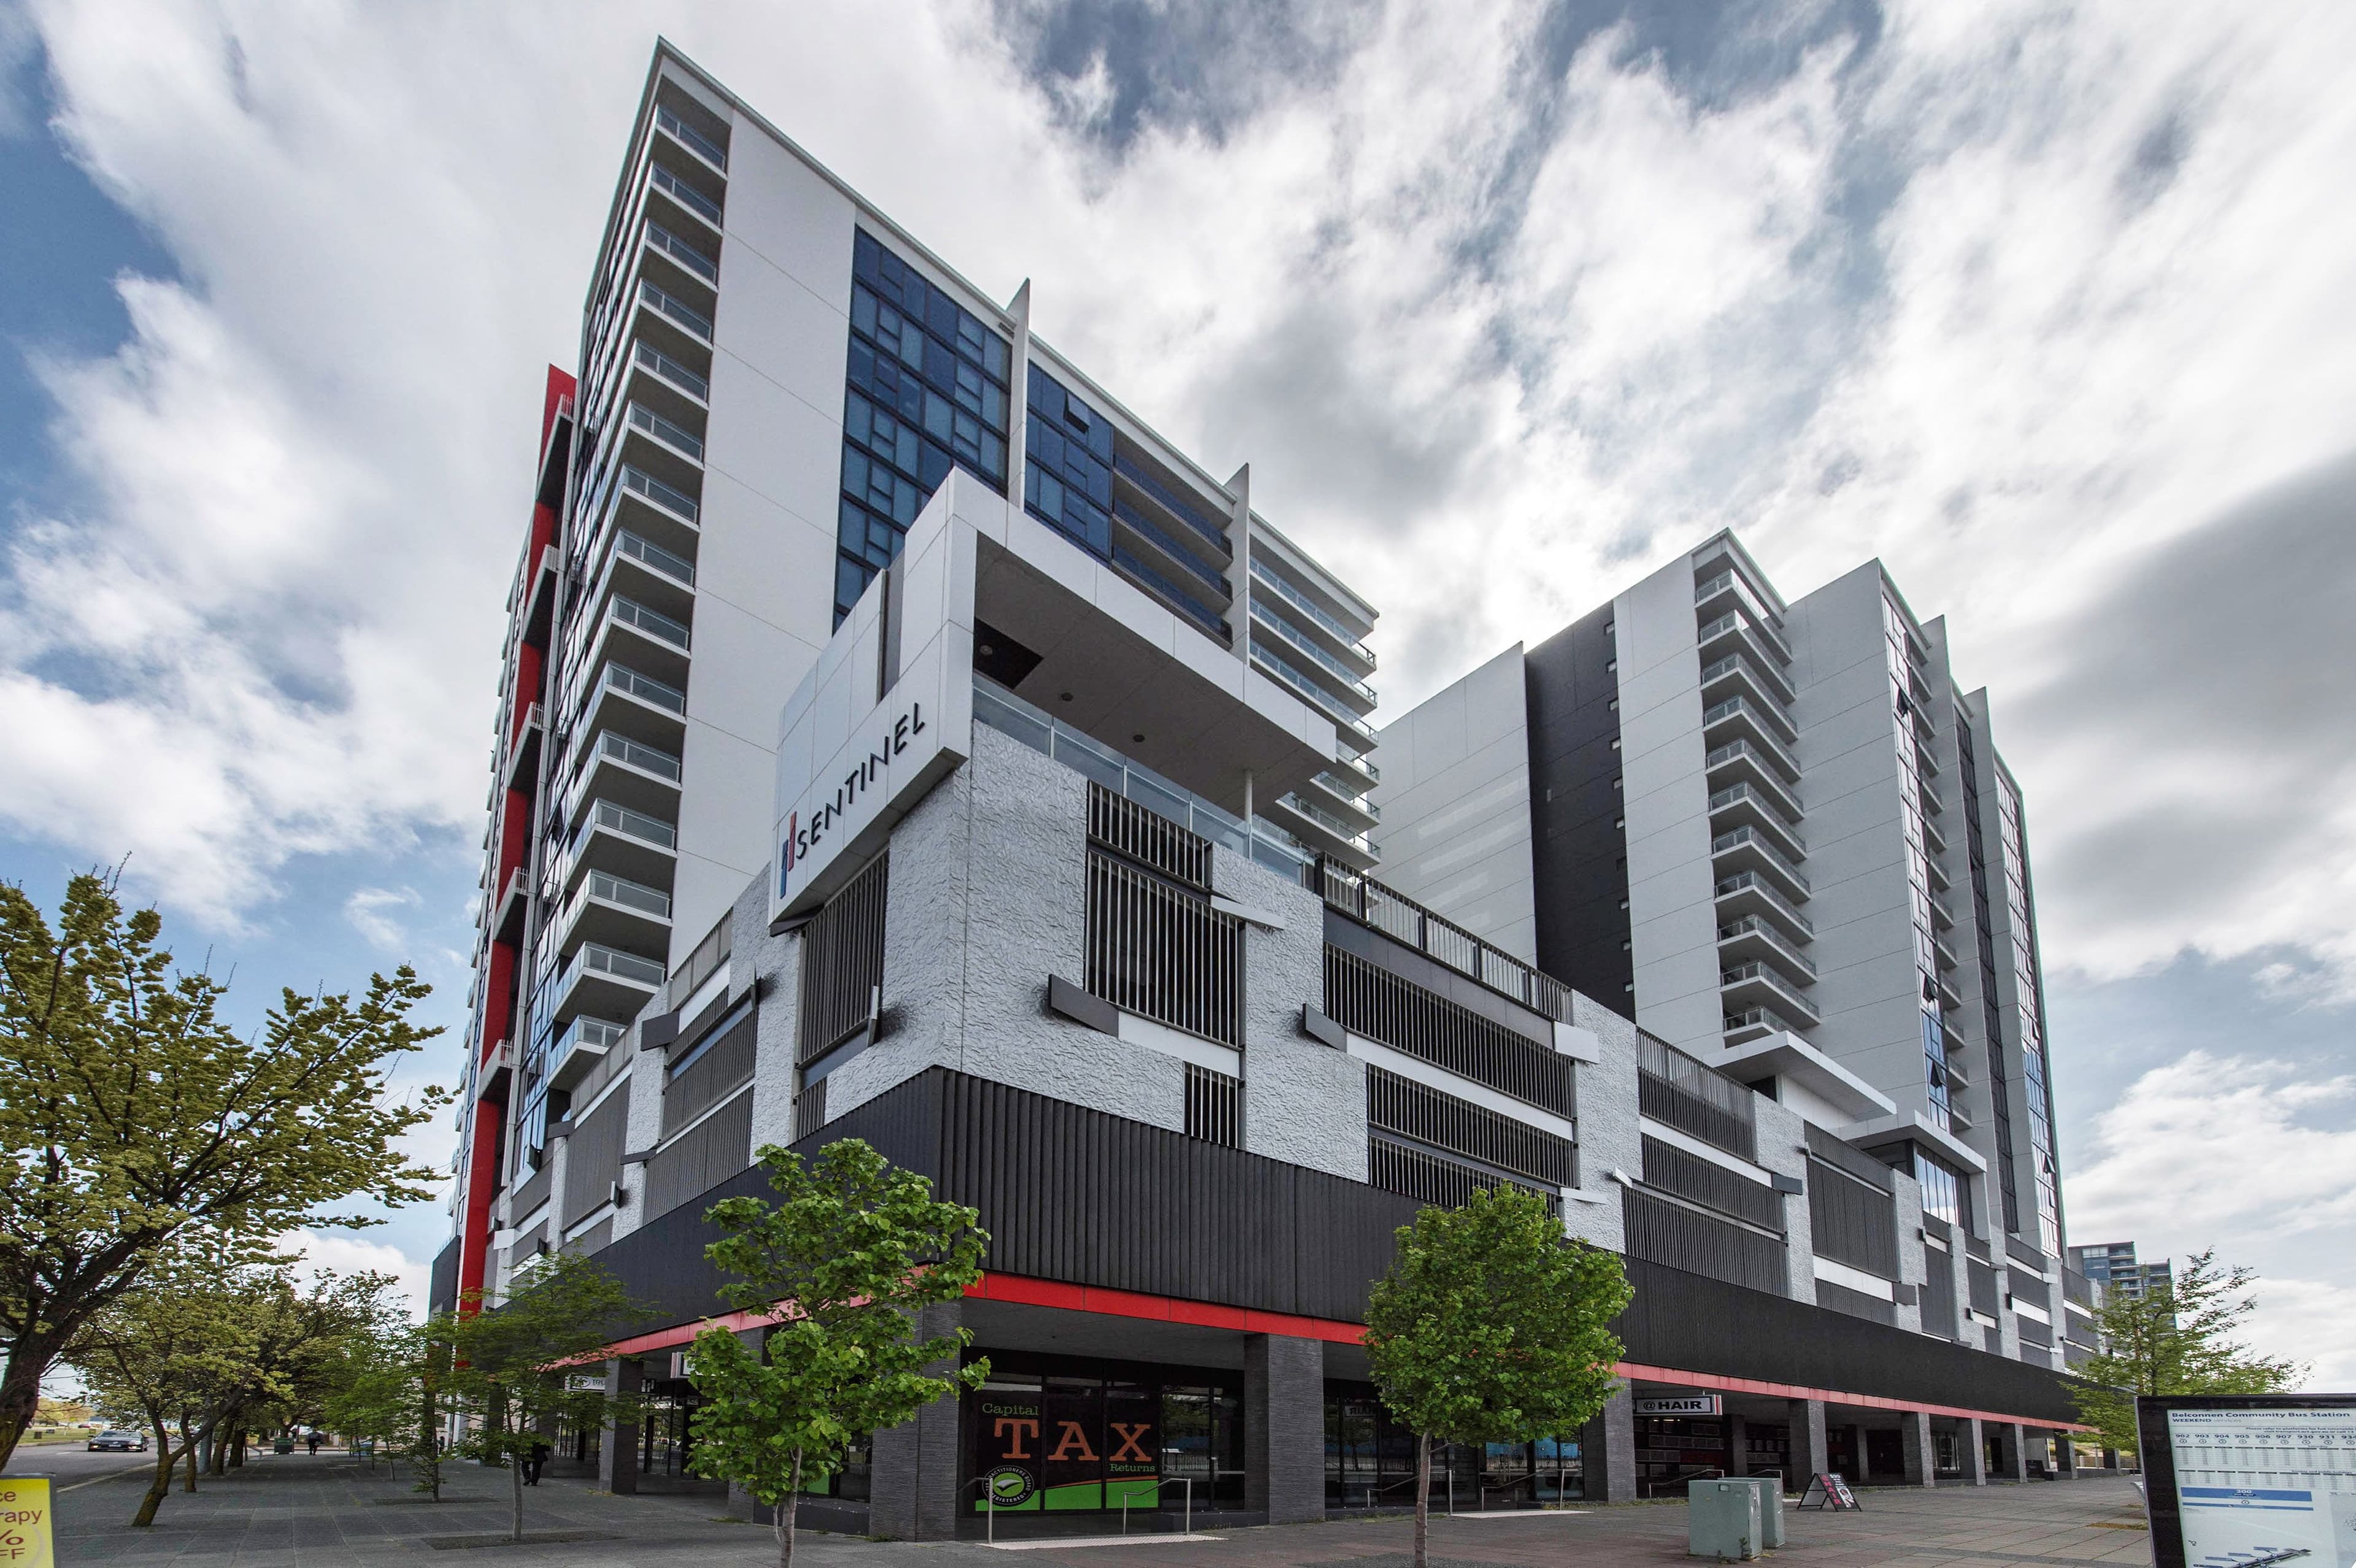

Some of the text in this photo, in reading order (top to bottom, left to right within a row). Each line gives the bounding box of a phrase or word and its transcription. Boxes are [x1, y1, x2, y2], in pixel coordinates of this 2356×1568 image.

[796, 702, 925, 859] SENTINEL
[982, 1403, 1039, 1416] Capital
[994, 1418, 1152, 1461] TAX
[987, 1467, 1026, 1480] RACTITIONERS
